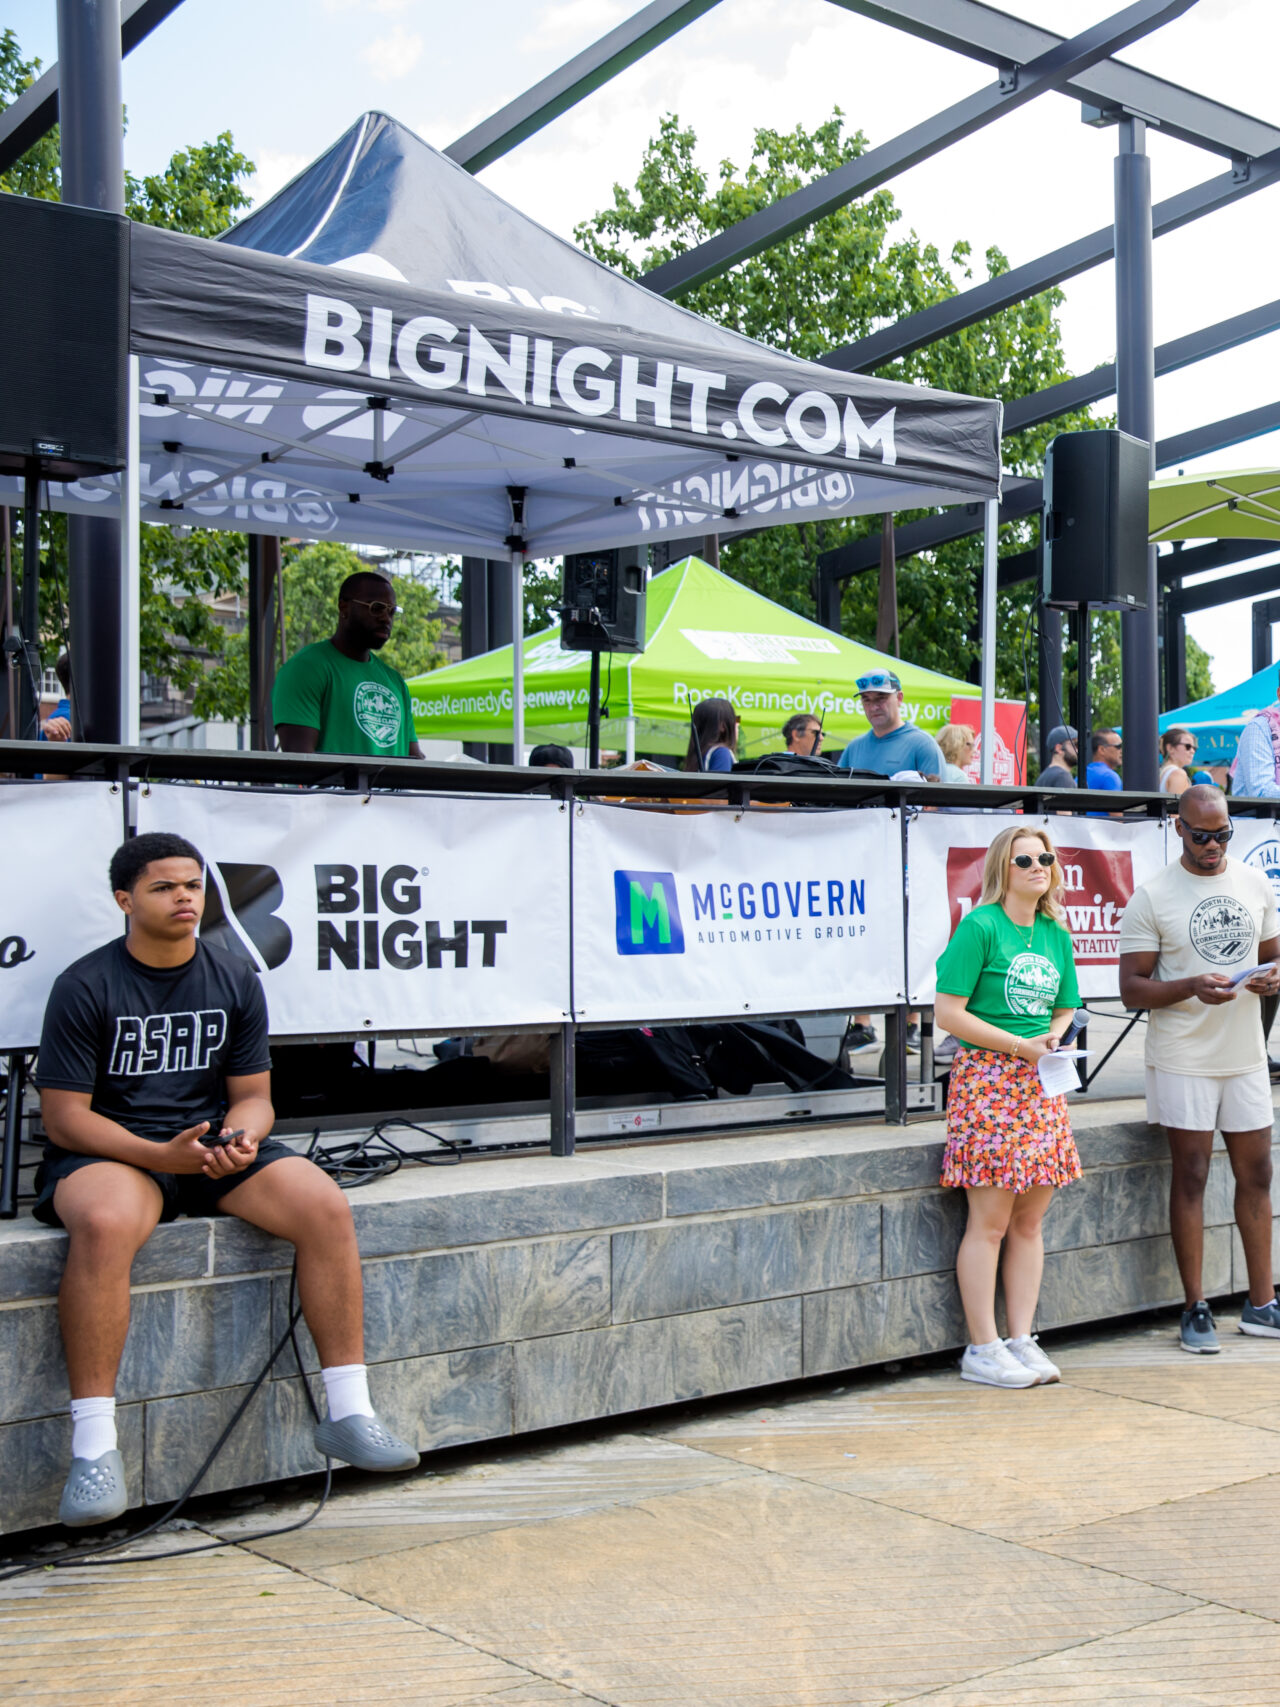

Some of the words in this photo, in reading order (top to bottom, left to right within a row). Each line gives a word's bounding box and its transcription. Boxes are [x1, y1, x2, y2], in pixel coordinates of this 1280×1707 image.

[303, 293, 897, 467] BIGNIGHT.COM
[314, 864, 422, 915] BIG
[1200, 898, 1222, 911] NORTH
[1223, 899, 1237, 907] END
[317, 920, 508, 971] NIGHT
[698, 928, 803, 945] AUTOMOTIVE
[814, 924, 867, 940] GROUP
[1195, 933, 1229, 945] CORNHOLE
[108, 1008, 228, 1077] ASAP
